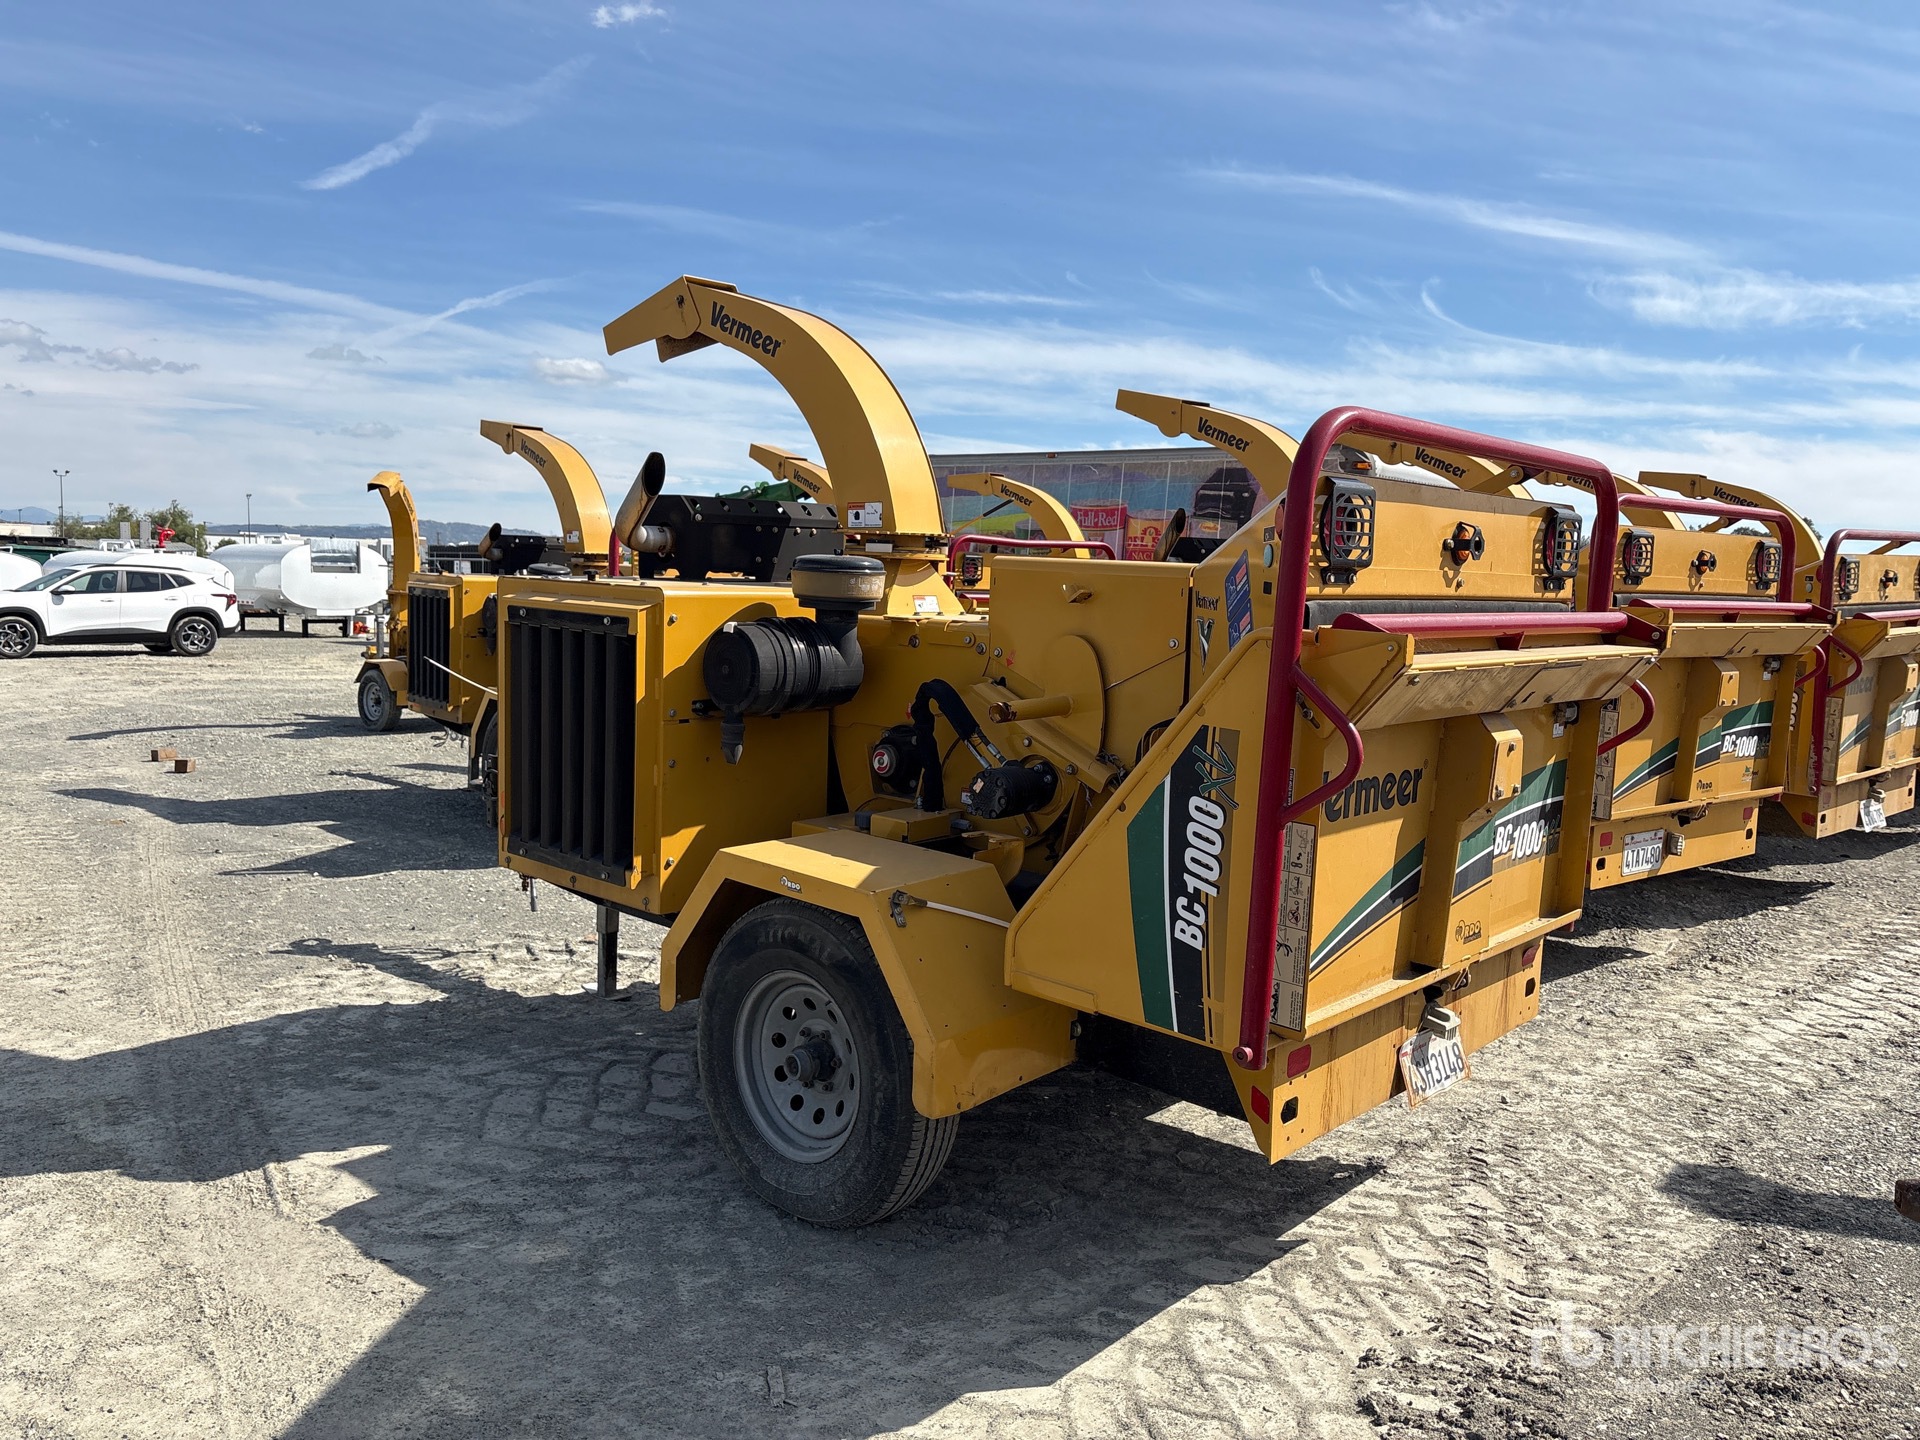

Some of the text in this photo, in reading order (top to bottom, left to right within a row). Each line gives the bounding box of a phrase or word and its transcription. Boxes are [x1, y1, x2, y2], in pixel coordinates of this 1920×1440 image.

[711, 301, 782, 358] Vermeer
[1197, 416, 1250, 453] Vermeer
[521, 438, 547, 468] Vermeer
[1415, 446, 1467, 479] Vermeer
[793, 469, 821, 494] Vermeer
[1000, 484, 1033, 507] Vermeer
[1077, 511, 1118, 527] Full-Red
[1625, 845, 1661, 870] 4TA7480
